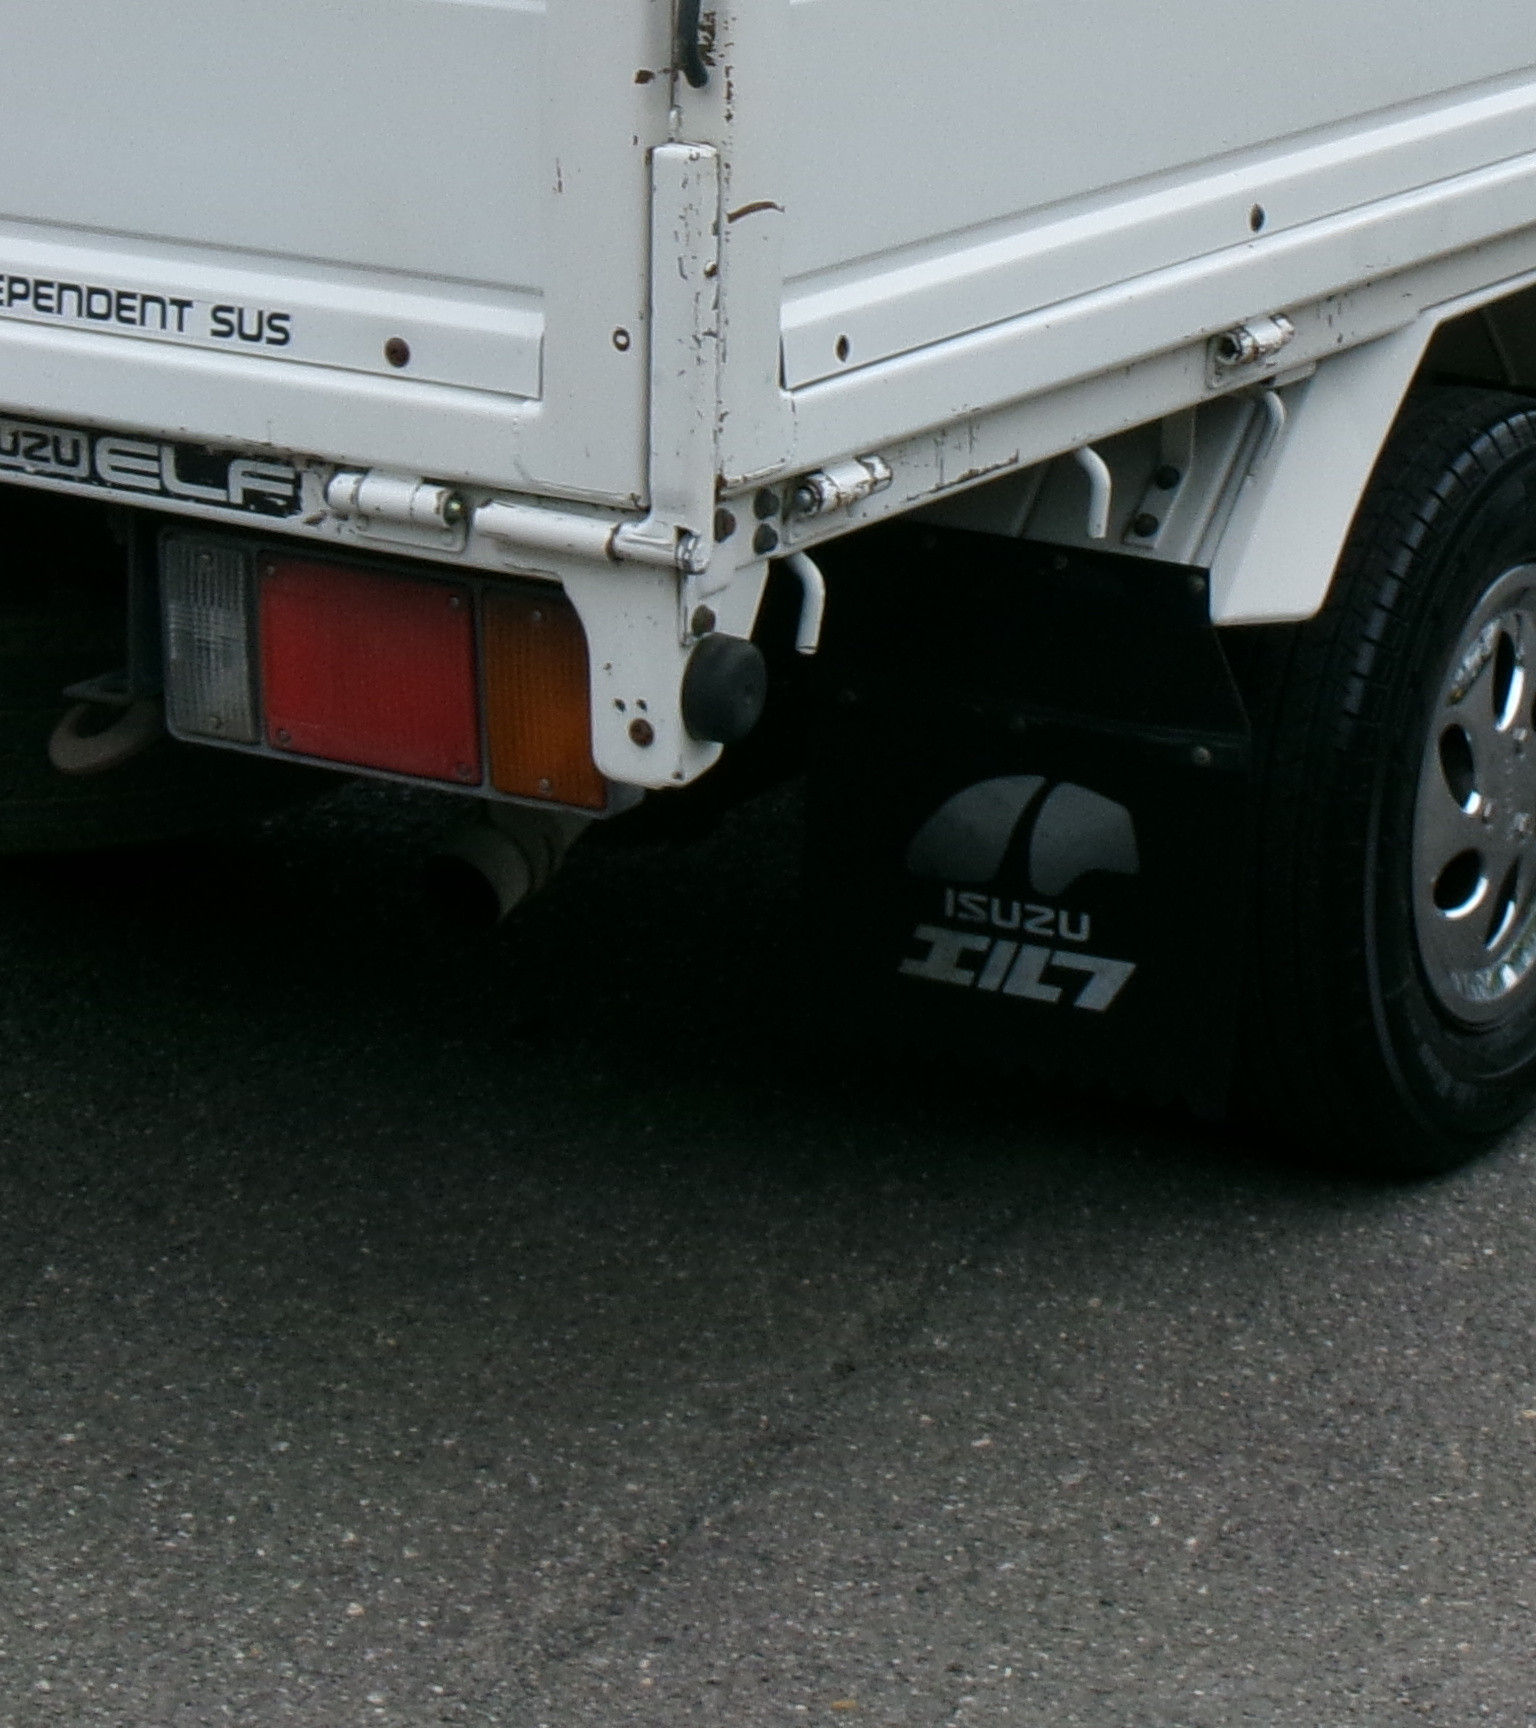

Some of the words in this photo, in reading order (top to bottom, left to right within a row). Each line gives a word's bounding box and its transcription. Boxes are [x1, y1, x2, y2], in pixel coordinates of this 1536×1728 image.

[209, 304, 292, 346] SUS
[94, 436, 299, 506] ELF
[944, 887, 1091, 943] ISUZU
[897, 922, 1138, 1013] エルフ
